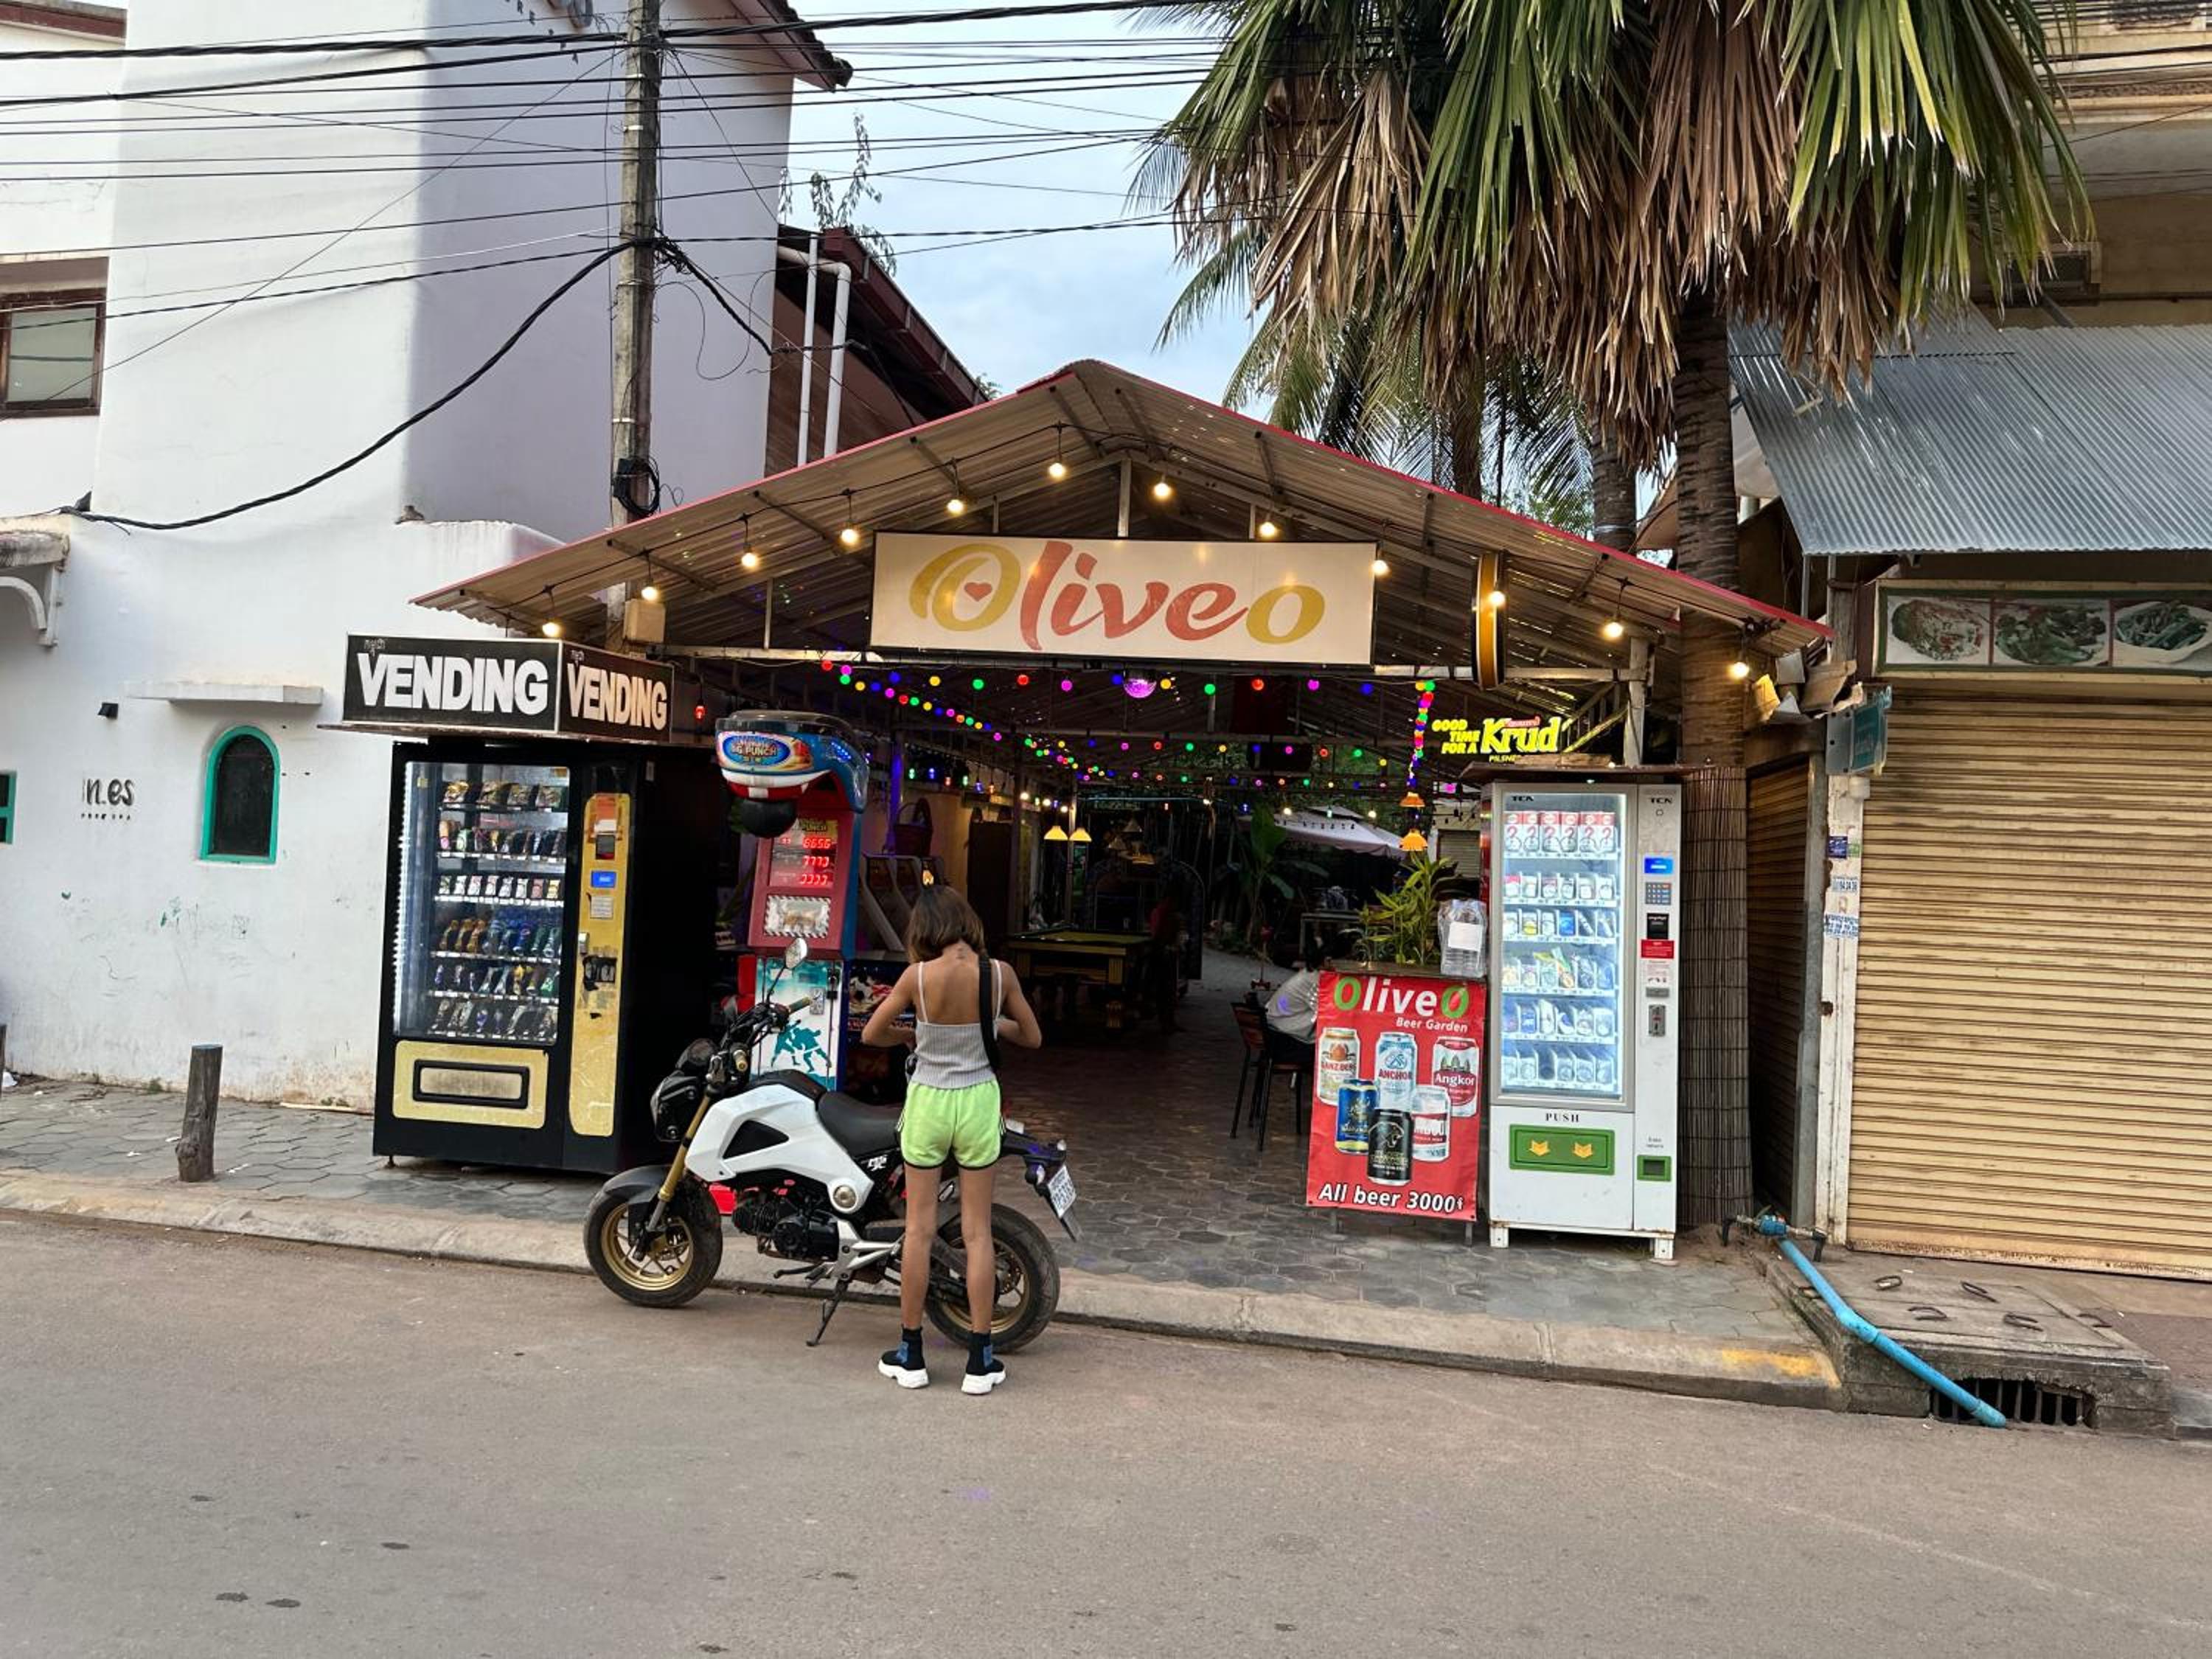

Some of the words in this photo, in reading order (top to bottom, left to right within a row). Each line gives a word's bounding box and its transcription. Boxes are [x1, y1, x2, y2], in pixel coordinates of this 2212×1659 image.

[357, 653, 548, 715] VENDING
[566, 662, 667, 731] VENDING
[1432, 719, 1468, 731] GOOD
[1450, 731, 1481, 742] TIME
[1481, 716, 1562, 754] Krud
[1441, 742, 1467, 754] FOR
[1467, 742, 1478, 754] A
[1396, 1017, 1422, 1030] Beer
[1426, 1018, 1468, 1033] Garden
[1435, 1073, 1475, 1087] Angkor
[1545, 1112, 1580, 1124] PUSH
[1318, 1183, 1348, 1203] All
[1354, 1185, 1401, 1208] beer
